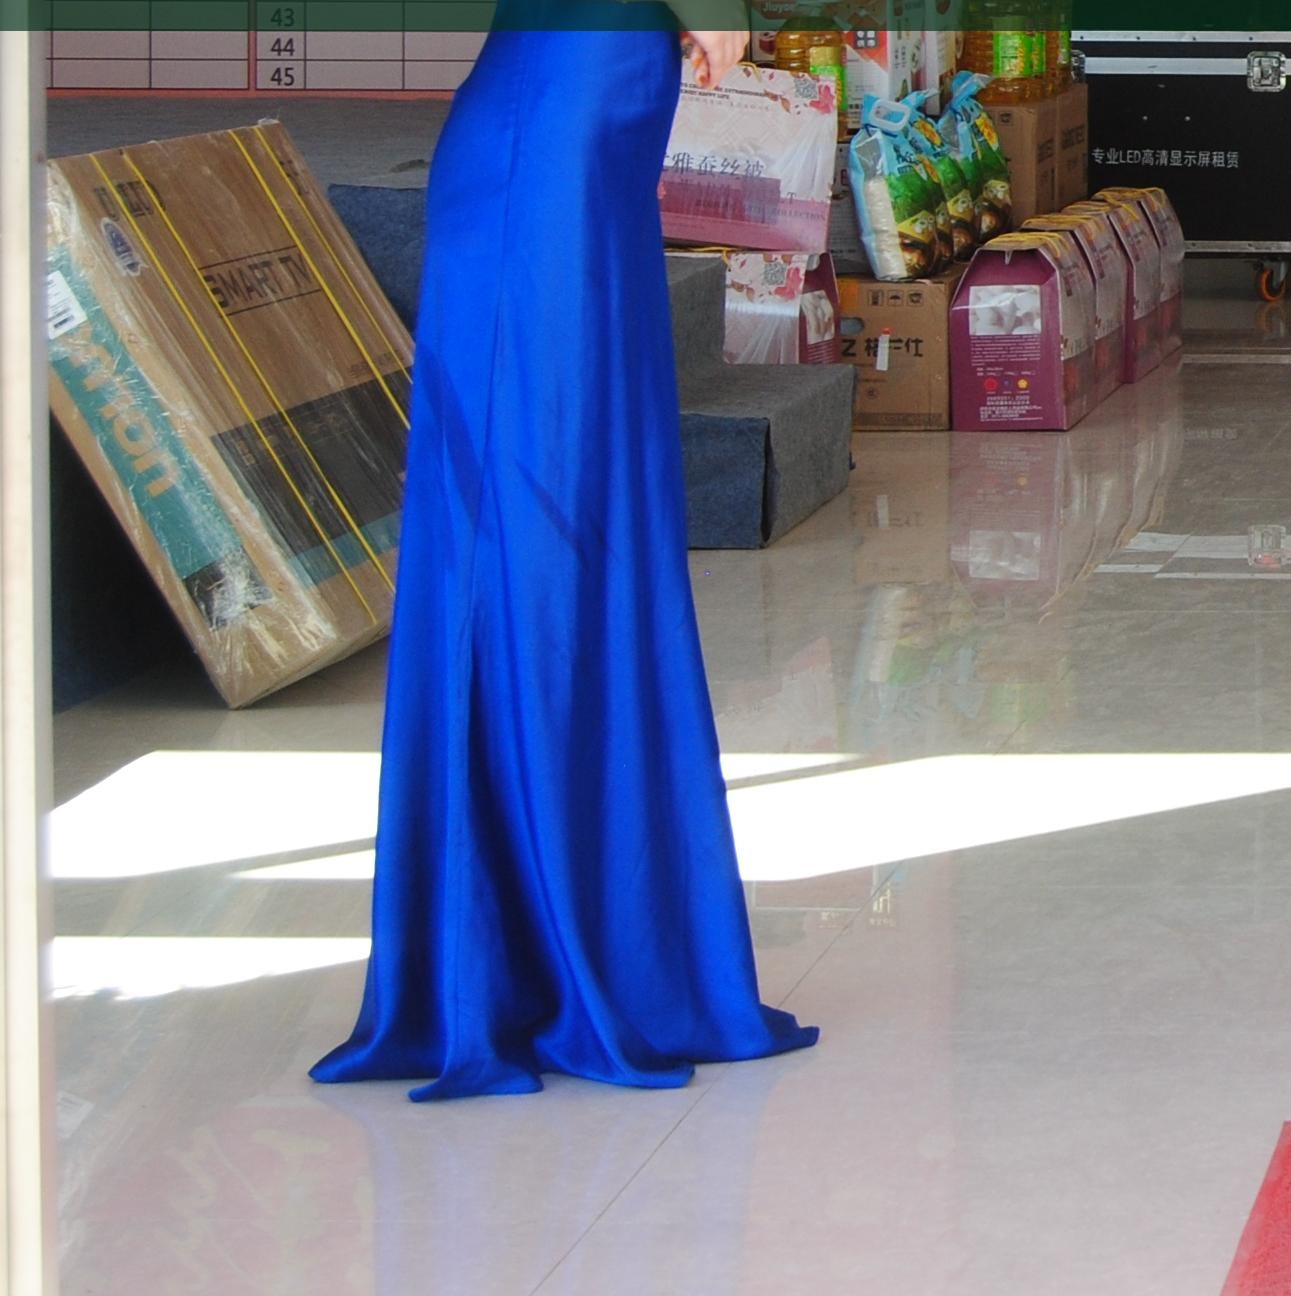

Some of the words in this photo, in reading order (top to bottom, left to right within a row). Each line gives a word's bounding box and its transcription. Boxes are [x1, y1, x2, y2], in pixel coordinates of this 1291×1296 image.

[270, 9, 297, 29] 43
[270, 38, 297, 58] 44
[270, 68, 297, 88] 45
[1091, 148, 1240, 169] 专业LED高清显示屏租赁
